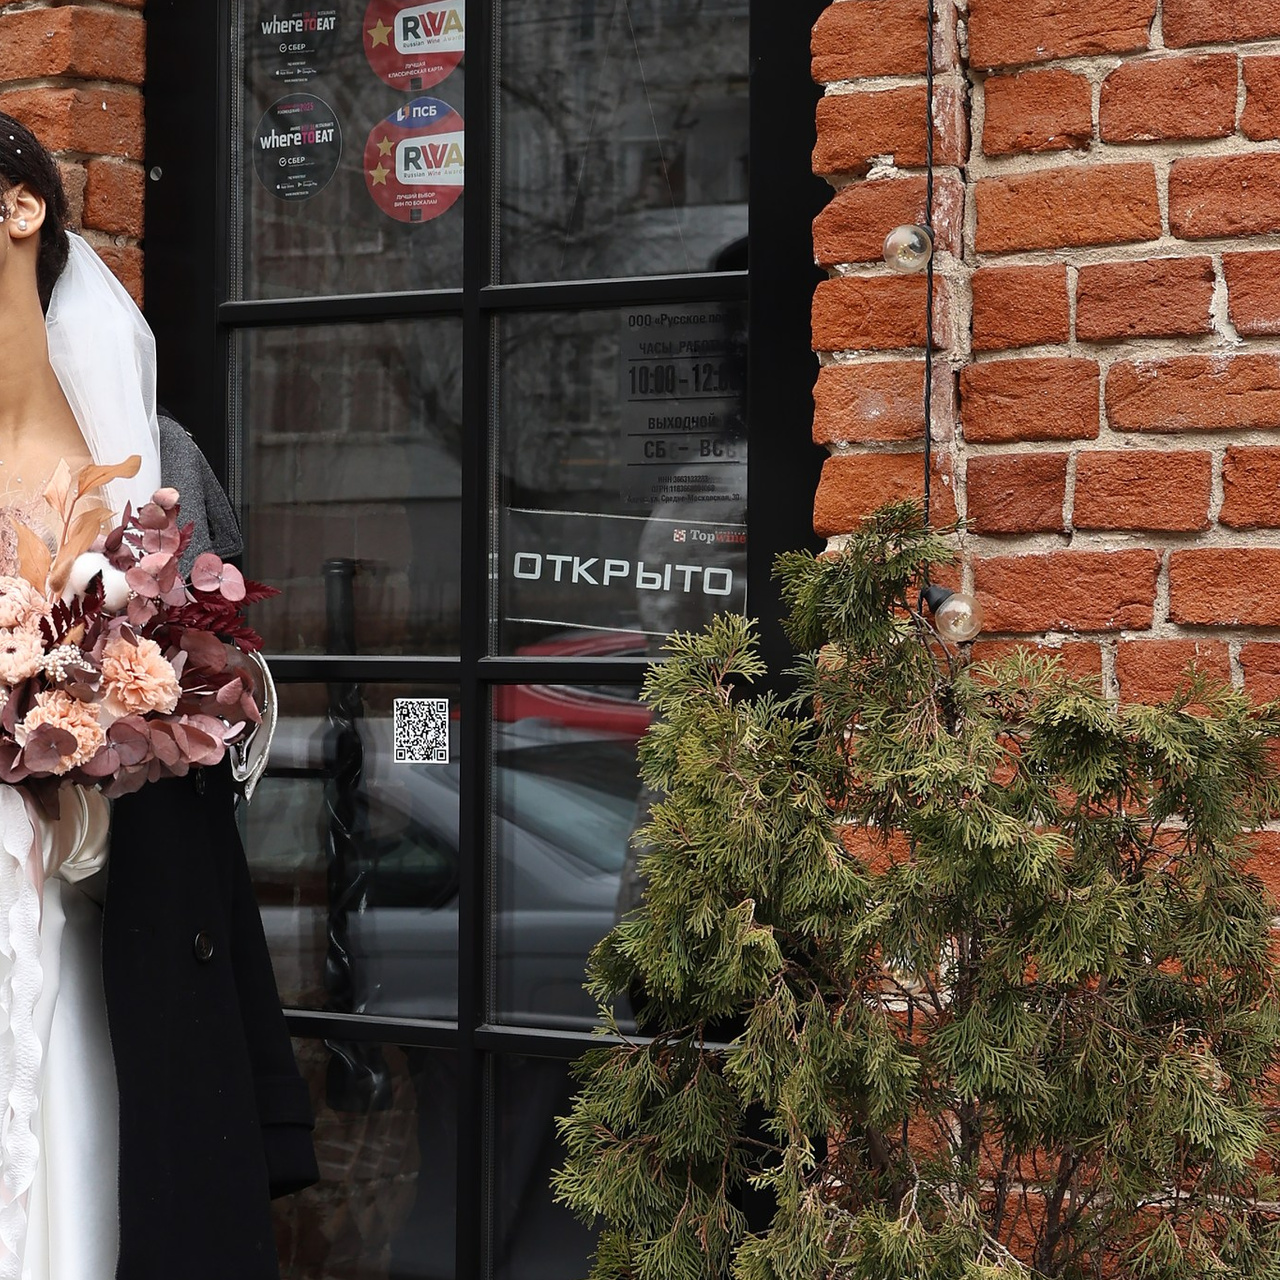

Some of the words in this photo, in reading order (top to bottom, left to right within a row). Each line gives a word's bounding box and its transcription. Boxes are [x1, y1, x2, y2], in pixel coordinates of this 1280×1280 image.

[402, 9, 464, 41] RWA
[403, 40, 424, 48] Russian
[388, 68, 427, 78] КЛАССИЧЕСКАЯ
[412, 106, 436, 118] ПСБ
[288, 156, 305, 164] СБЕР
[404, 142, 464, 171] RWA
[396, 192, 417, 200] ЛУЧШИЙ
[628, 314, 652, 327] ООО
[639, 342, 672, 354] ЧАСЫ
[628, 364, 676, 394] 10:00
[648, 412, 716, 430] ВЫХОДНОЙ
[644, 440, 666, 458] СБ
[700, 439, 723, 457] ВС
[513, 552, 733, 596] ОТКРЫТО
